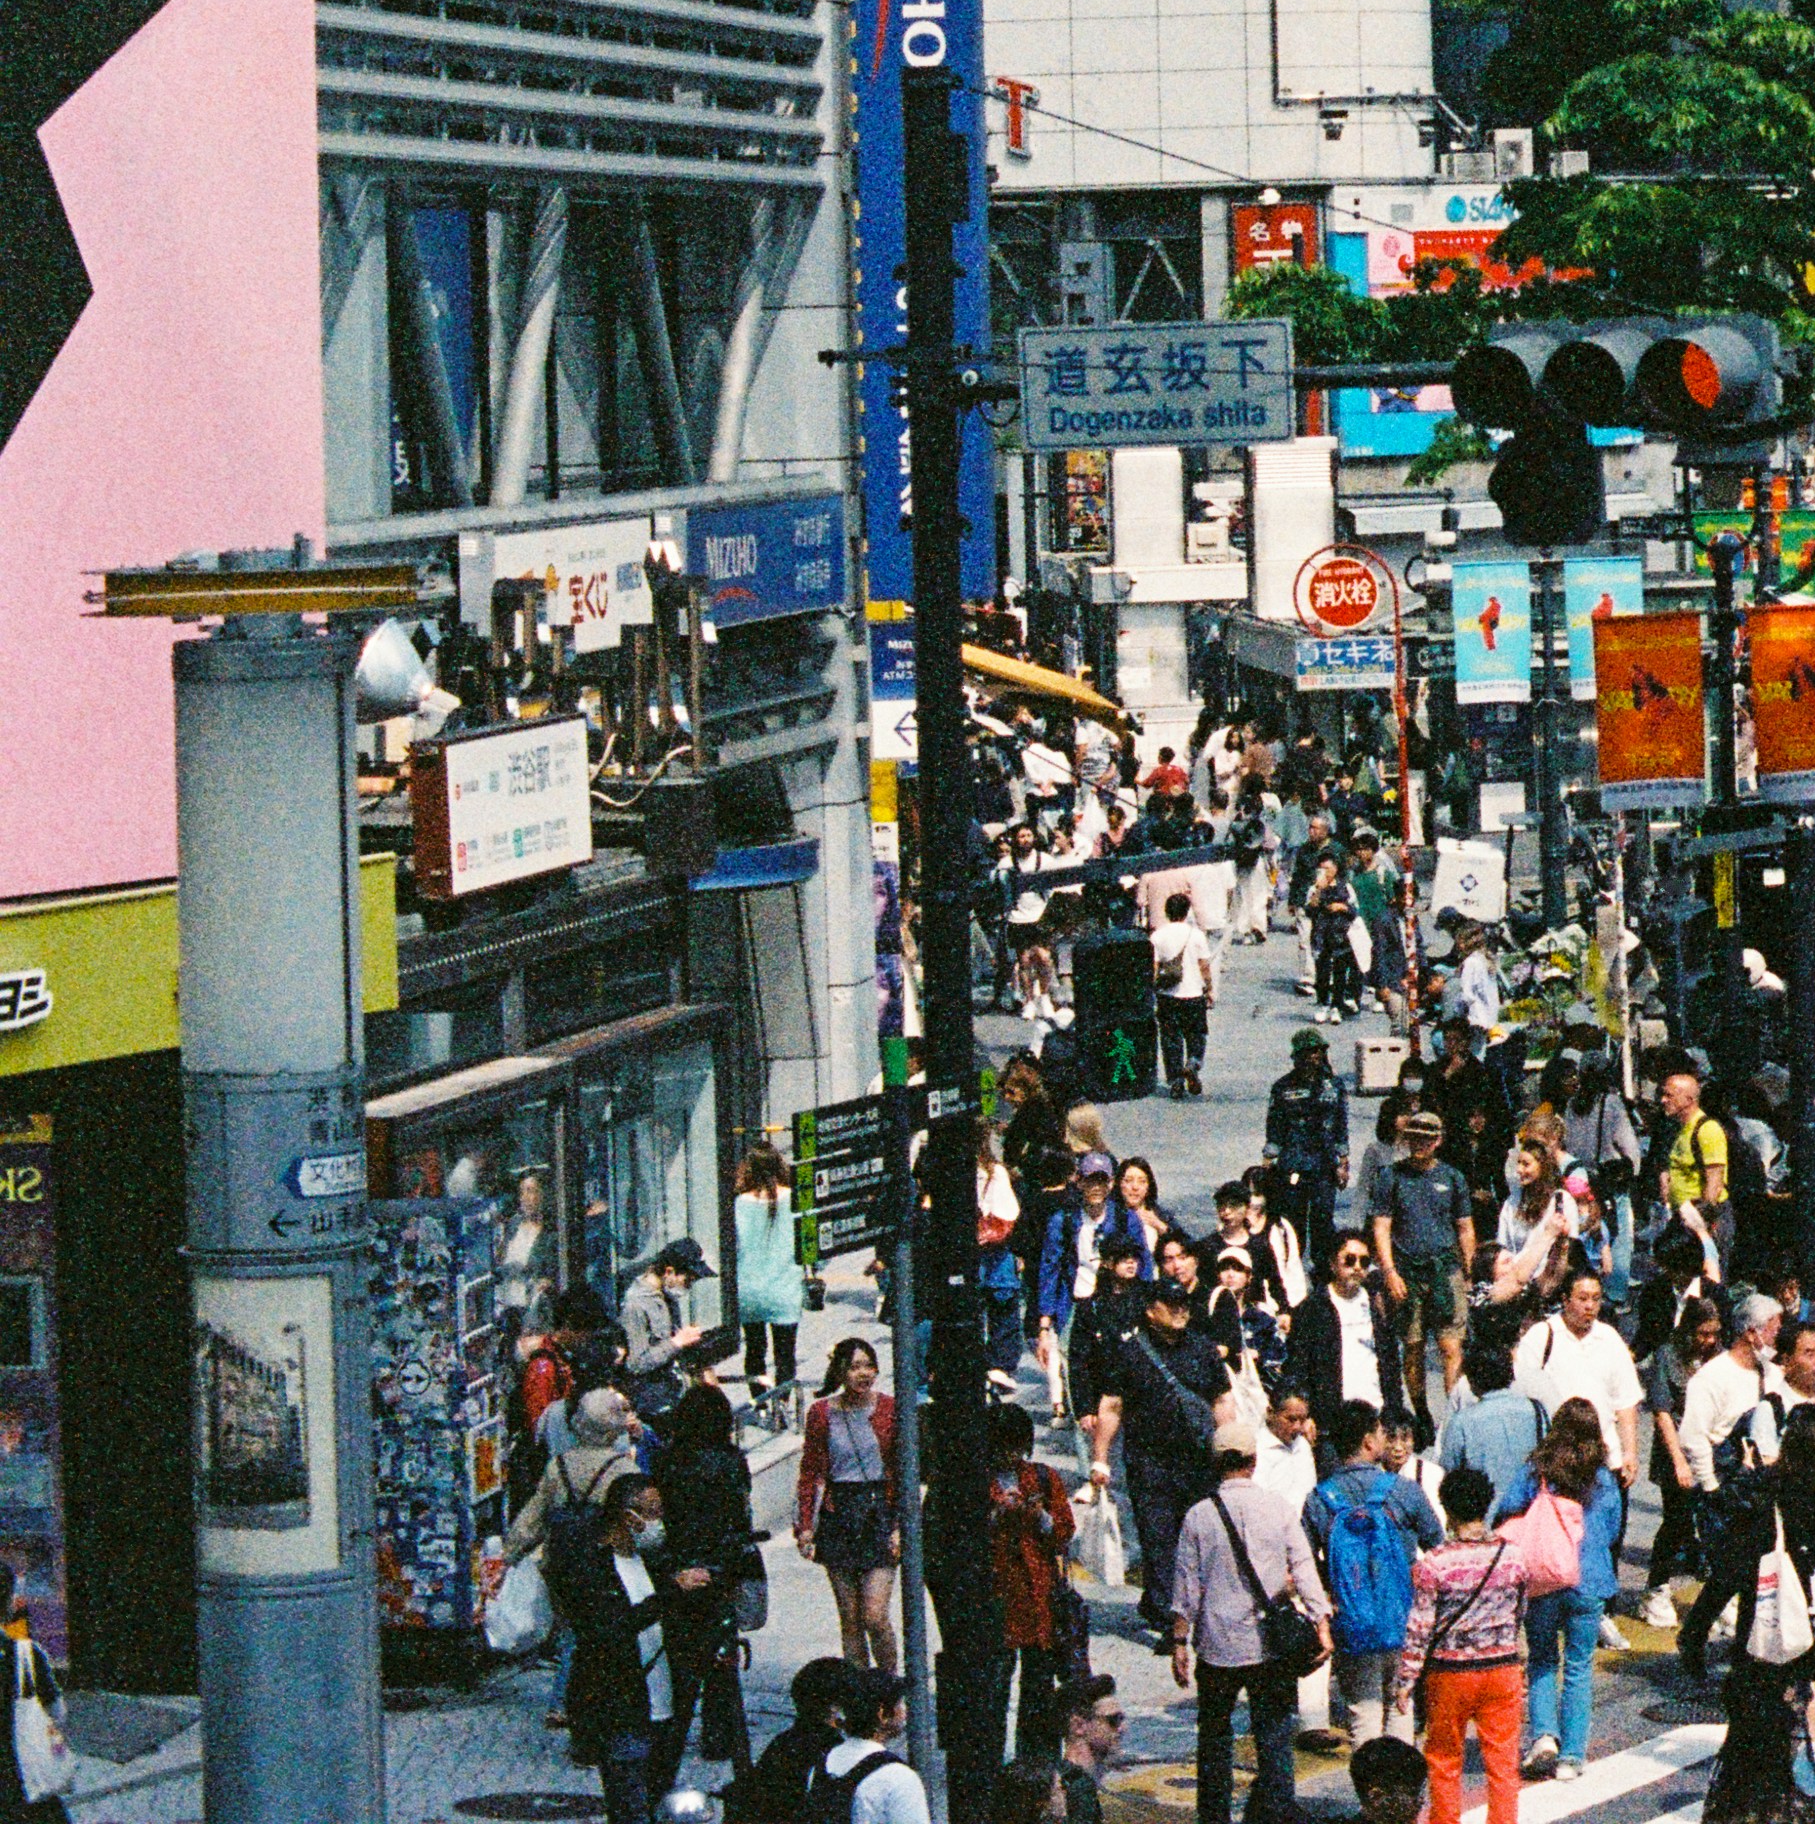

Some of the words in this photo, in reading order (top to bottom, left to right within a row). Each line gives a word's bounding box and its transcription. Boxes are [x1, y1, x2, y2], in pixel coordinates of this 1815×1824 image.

[1044, 339, 1268, 397] 道玄坂下
[1049, 401, 1195, 437] Dogenzaka
[1203, 398, 1267, 428] shita
[1314, 577, 1373, 609] 消火栓
[1321, 640, 1395, 666] セキネ
